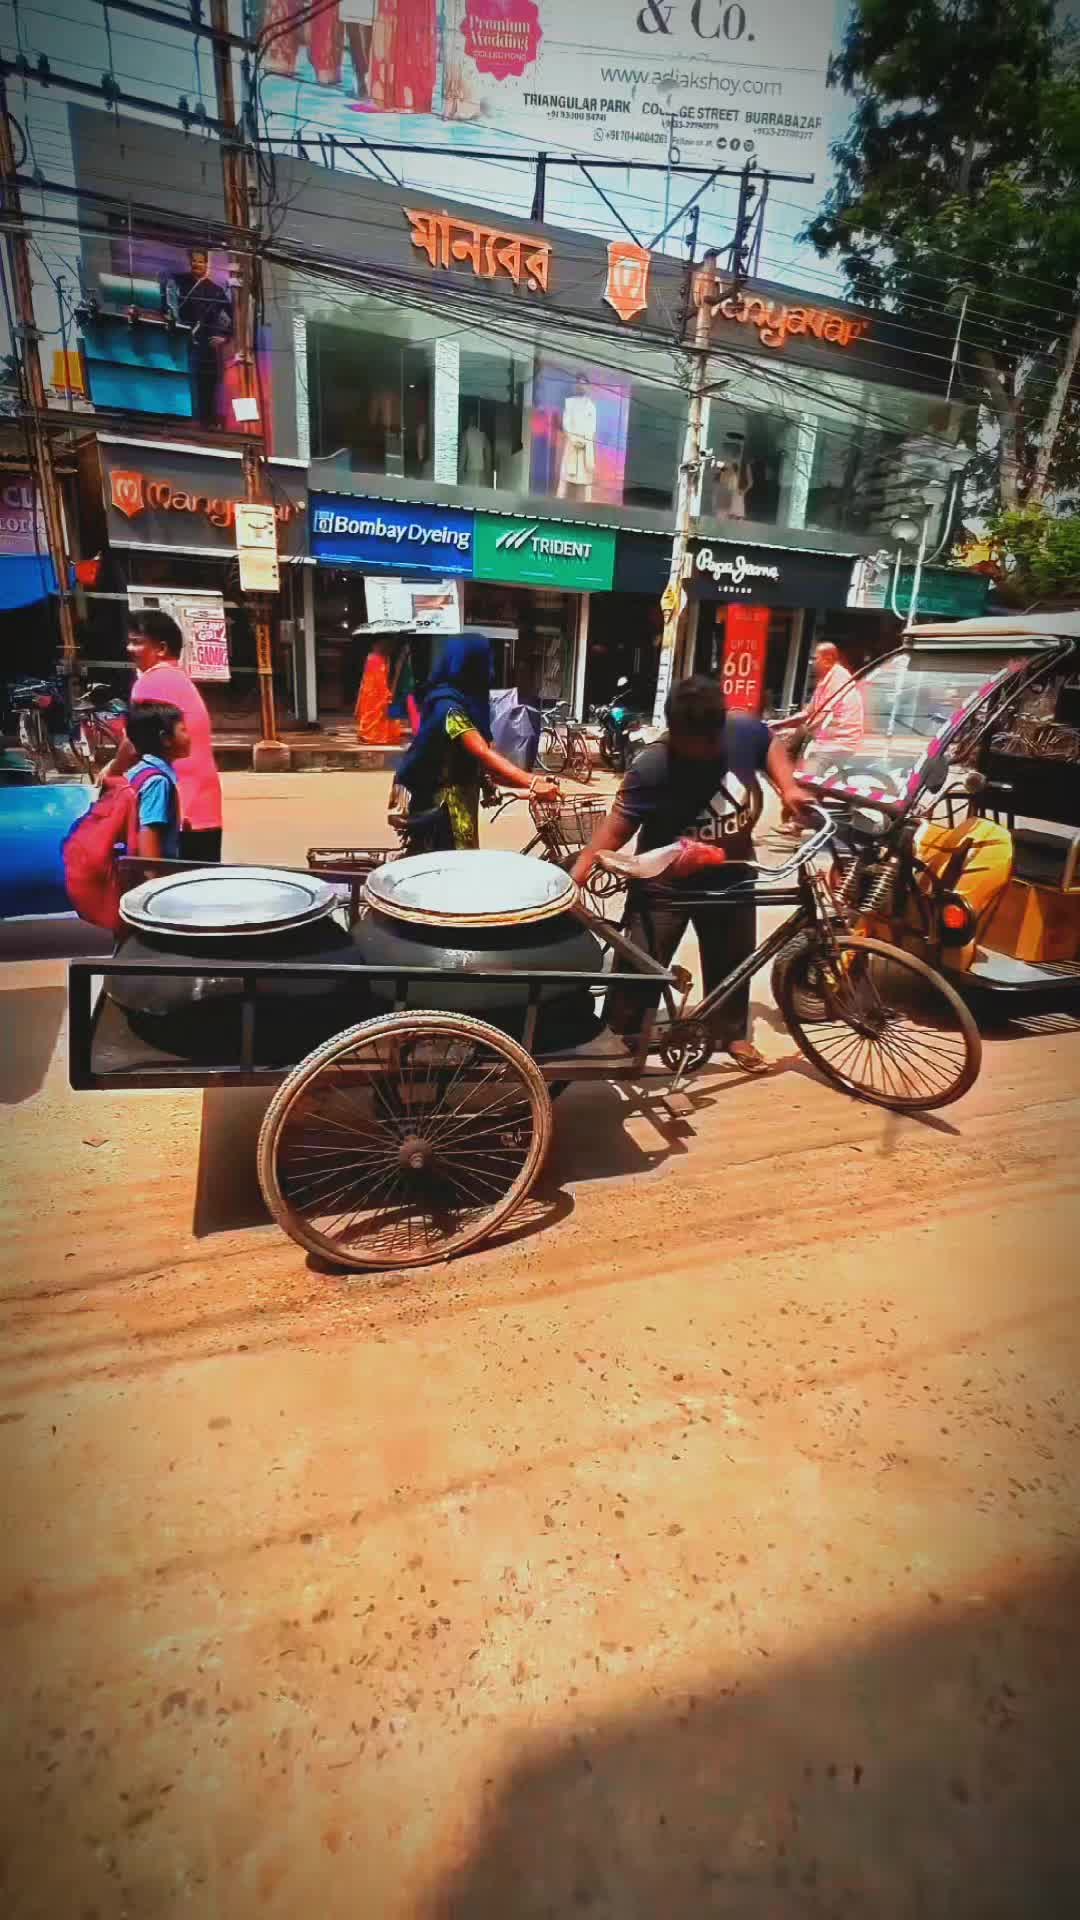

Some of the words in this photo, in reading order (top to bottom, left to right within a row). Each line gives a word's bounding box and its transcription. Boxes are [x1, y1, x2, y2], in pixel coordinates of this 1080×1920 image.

[469, 15, 530, 33] Premium
[636, 0, 677, 35] &
[690, 0, 755, 41] Co.
[470, 31, 529, 51] Wedding
[523, 92, 598, 112] TRIANGULAR
[599, 98, 631, 114] PARK
[642, 101, 694, 119] COGE
[697, 107, 740, 122] STREET
[402, 207, 553, 293] মান্যবর
[334, 515, 406, 543] Bombay
[408, 524, 472, 550] Dyeing
[531, 536, 593, 558] TRIDENT
[723, 680, 756, 695] OFF
